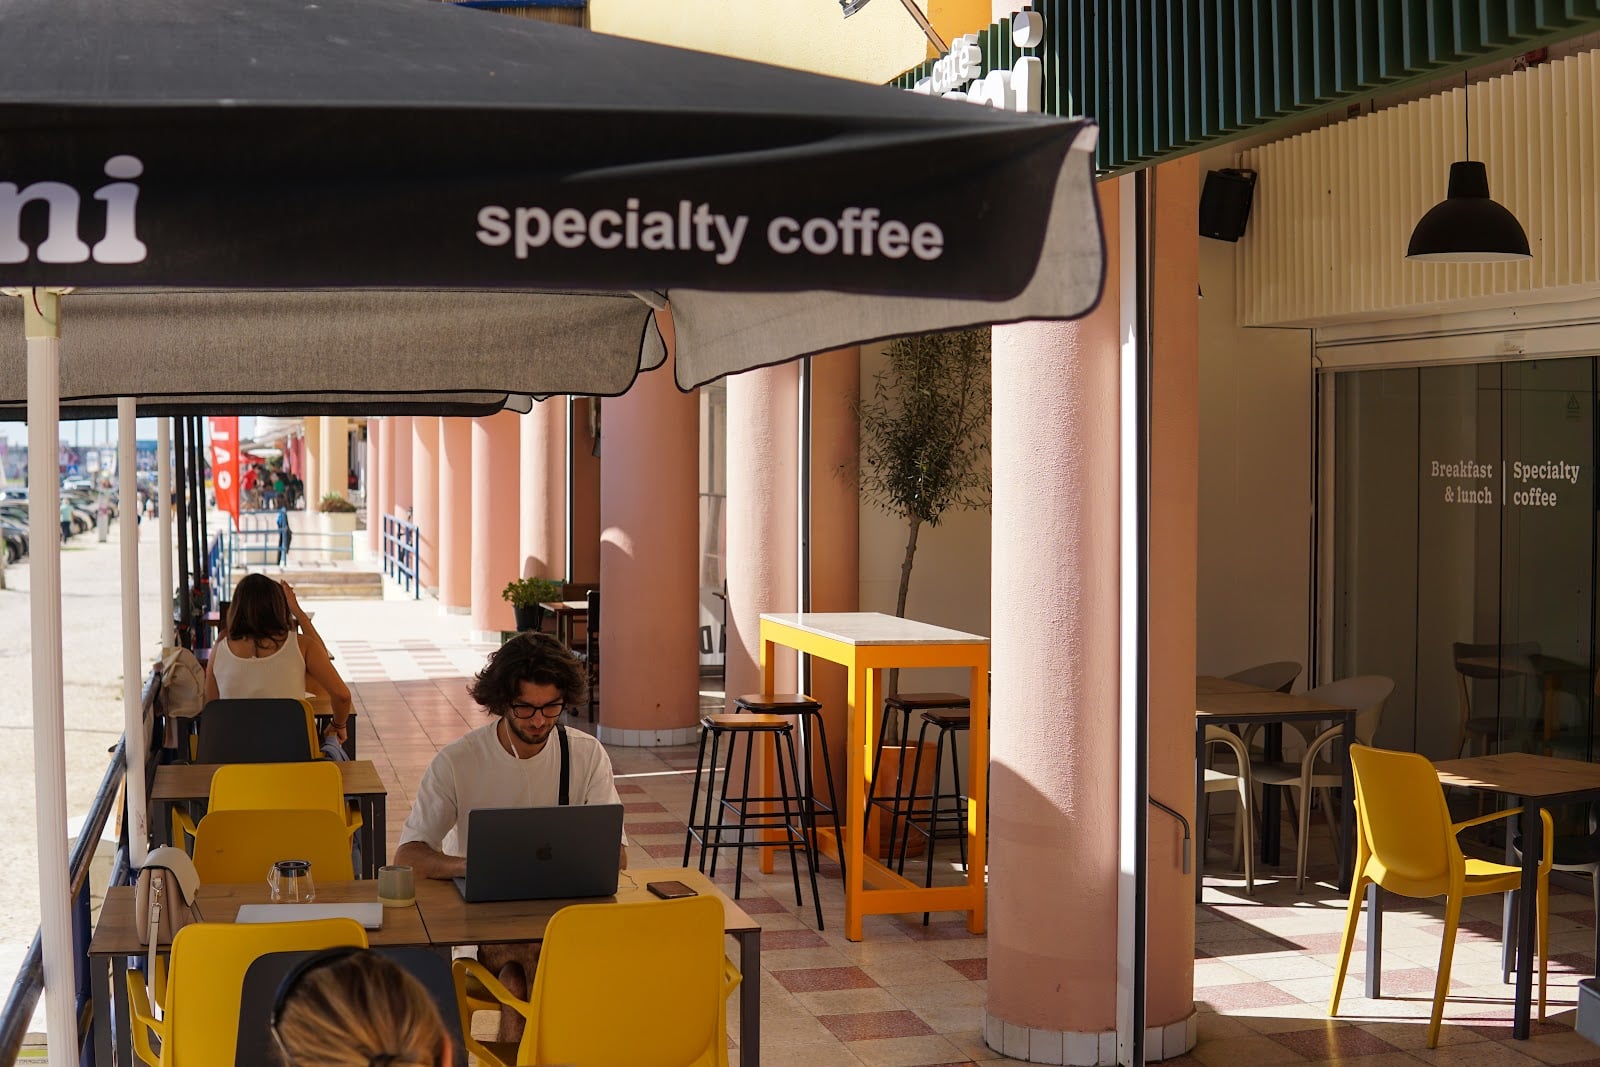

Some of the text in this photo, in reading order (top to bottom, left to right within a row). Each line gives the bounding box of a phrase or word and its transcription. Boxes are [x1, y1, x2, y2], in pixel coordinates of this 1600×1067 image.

[476, 198, 944, 265] specialty coffee
[1431, 460, 1493, 479] Breakfast
[1513, 460, 1580, 484] Specialty
[1444, 486, 1493, 505] & lunch
[1513, 487, 1557, 507] coffee
